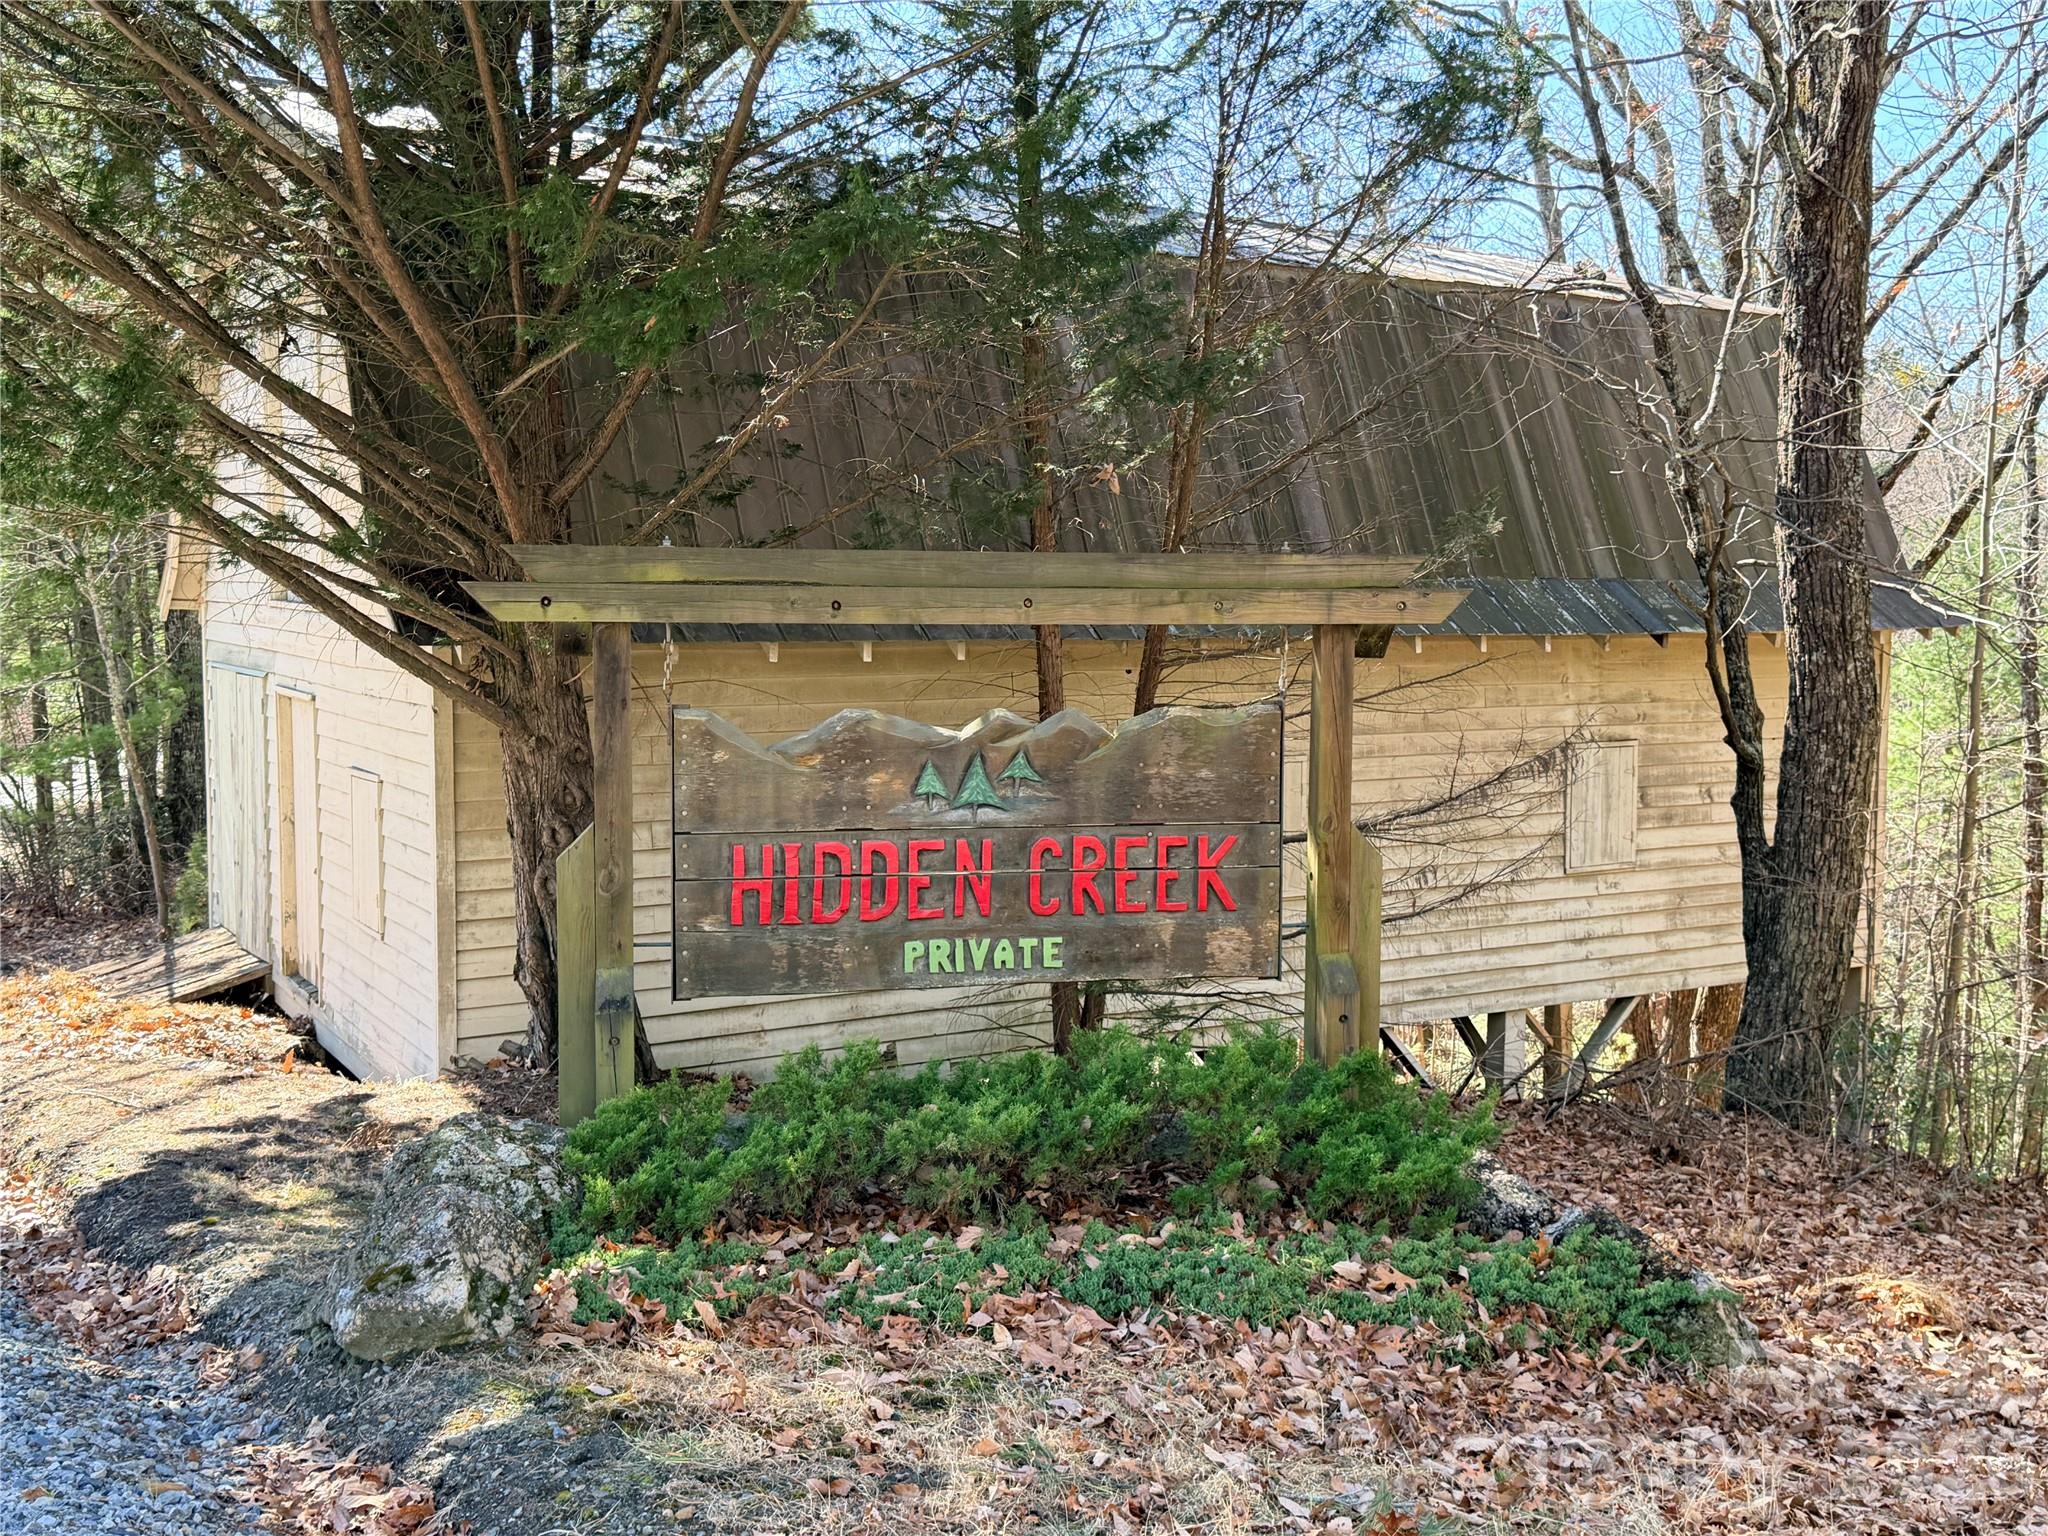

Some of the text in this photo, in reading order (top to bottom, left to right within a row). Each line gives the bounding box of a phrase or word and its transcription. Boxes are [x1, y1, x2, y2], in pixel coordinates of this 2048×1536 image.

[730, 834, 1240, 926] HIDDEN CREEK
[903, 936, 1065, 974] PRIVATE
